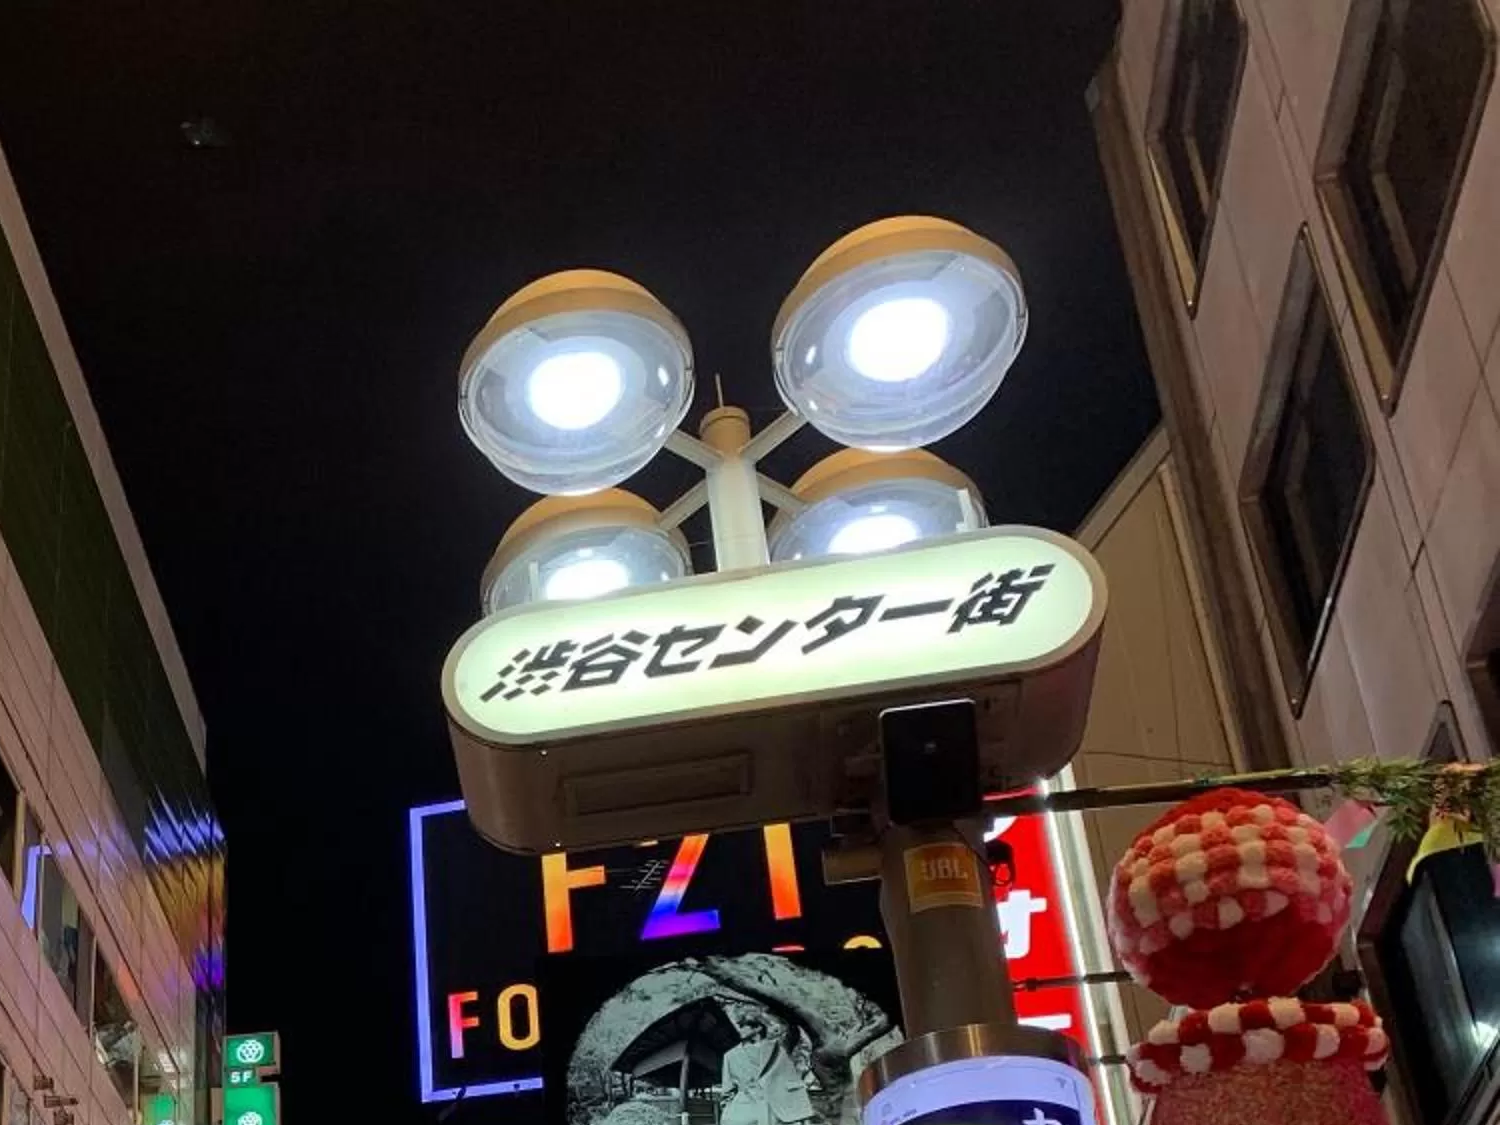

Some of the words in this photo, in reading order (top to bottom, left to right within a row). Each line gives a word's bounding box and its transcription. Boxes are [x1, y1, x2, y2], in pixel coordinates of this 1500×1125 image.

[480, 563, 1055, 703] 渋谷センター街
[921, 857, 968, 882] JBL
[231, 1071, 253, 1083] 5F
